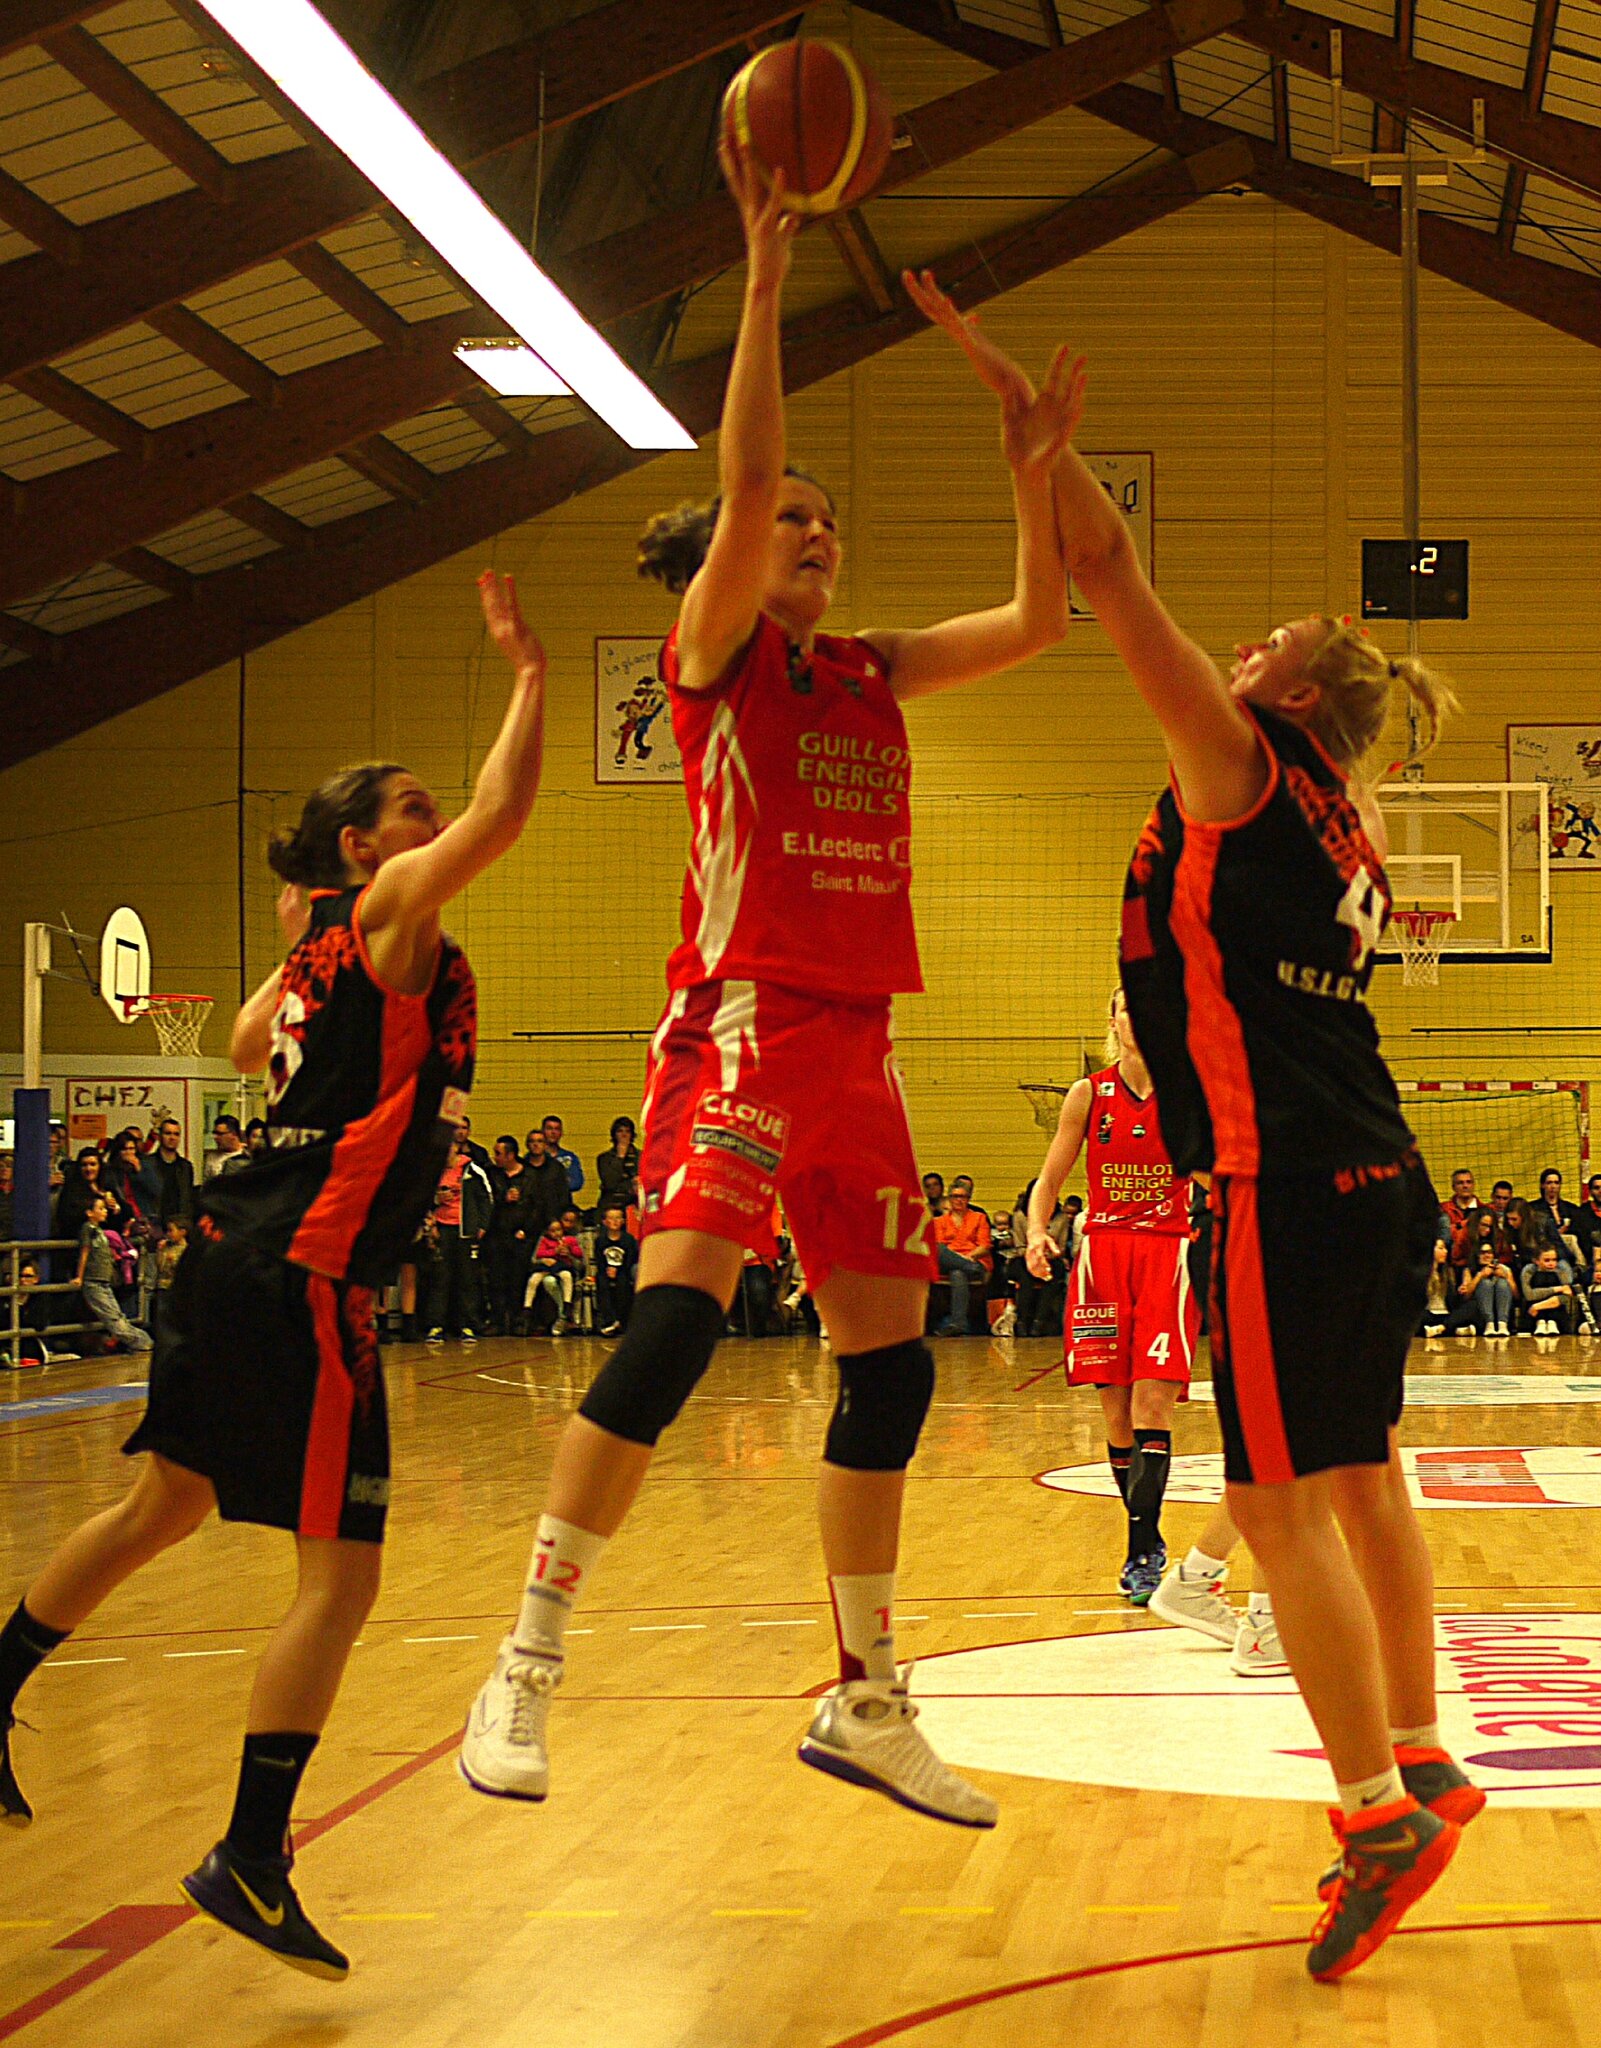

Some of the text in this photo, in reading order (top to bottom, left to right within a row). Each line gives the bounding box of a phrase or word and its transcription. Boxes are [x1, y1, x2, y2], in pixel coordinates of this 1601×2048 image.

[813, 787, 899, 815] DEOLS
[782, 831, 884, 862] E.Leclerc
[74, 1086, 154, 1108] CHEZ
[1100, 1163, 1173, 1176] GUILLOT
[1109, 1188, 1165, 1202] DEOLS
[875, 1186, 932, 1256] 12
[1073, 1305, 1117, 1319] CLOUÉ
[1146, 1332, 1170, 1366] 4
[534, 1553, 582, 1594] 12
